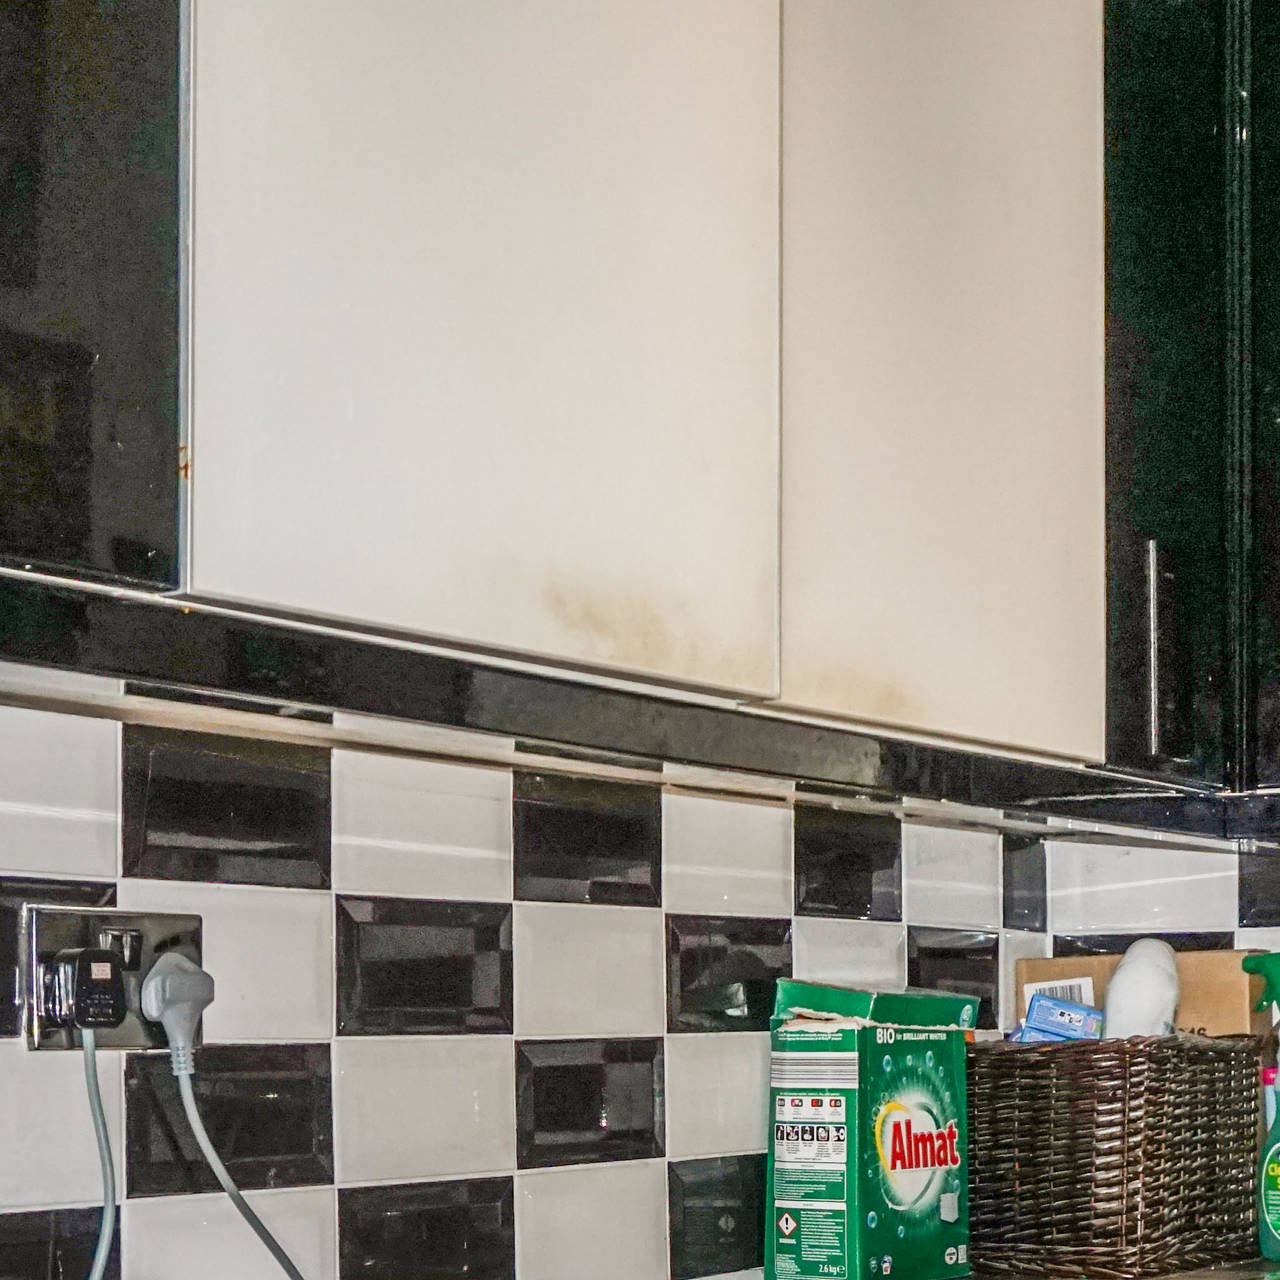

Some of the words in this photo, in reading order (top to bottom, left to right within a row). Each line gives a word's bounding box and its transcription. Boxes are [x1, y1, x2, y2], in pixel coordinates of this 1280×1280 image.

[876, 1028, 895, 1044] BIO
[903, 1032, 929, 1041] BRILLIANT
[890, 1118, 960, 1171] Almat
[818, 1264, 829, 1273] 2.6
